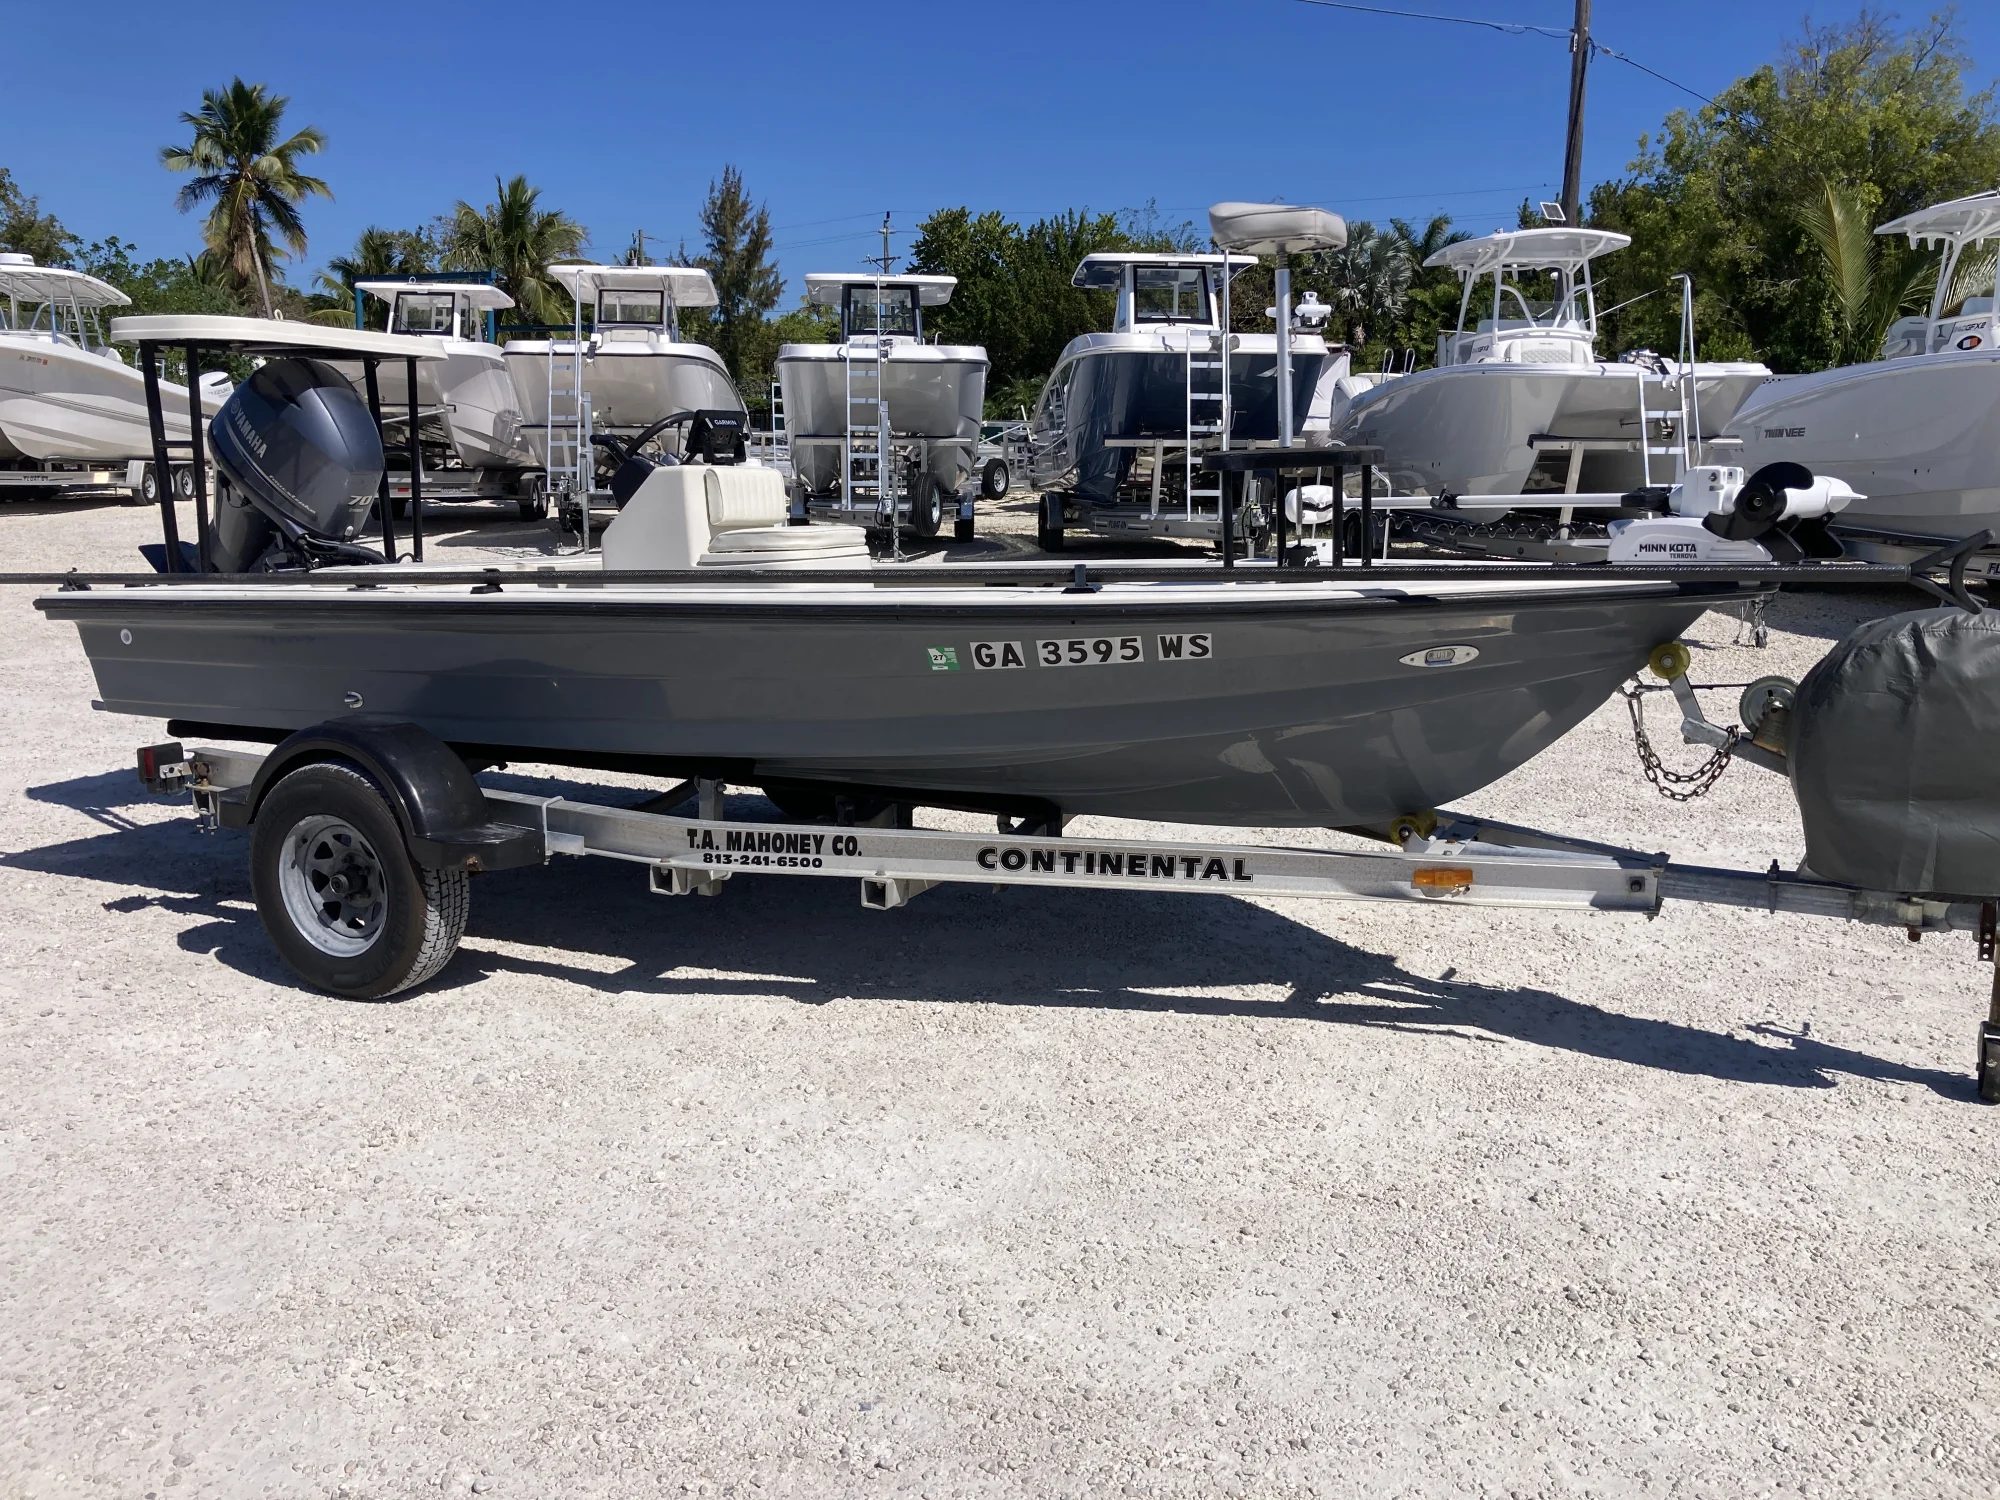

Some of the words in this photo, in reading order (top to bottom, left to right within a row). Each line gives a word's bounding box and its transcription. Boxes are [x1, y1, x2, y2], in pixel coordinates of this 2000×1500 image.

[233, 409, 268, 459] YAMAHA
[348, 495, 373, 506] 70
[1639, 543, 1667, 553] MINN
[1669, 543, 1697, 553] KOTA
[1669, 552, 1698, 560] TERROVA
[974, 642, 1024, 668] GA
[1041, 637, 1140, 665] 3595
[1159, 634, 1210, 658] WS
[686, 828, 720, 850] T.A.
[726, 831, 825, 855] MAHONEY
[832, 835, 863, 857] CO.
[703, 853, 823, 868] 813-241-6500
[975, 846, 1254, 883] CONTINENTAL
